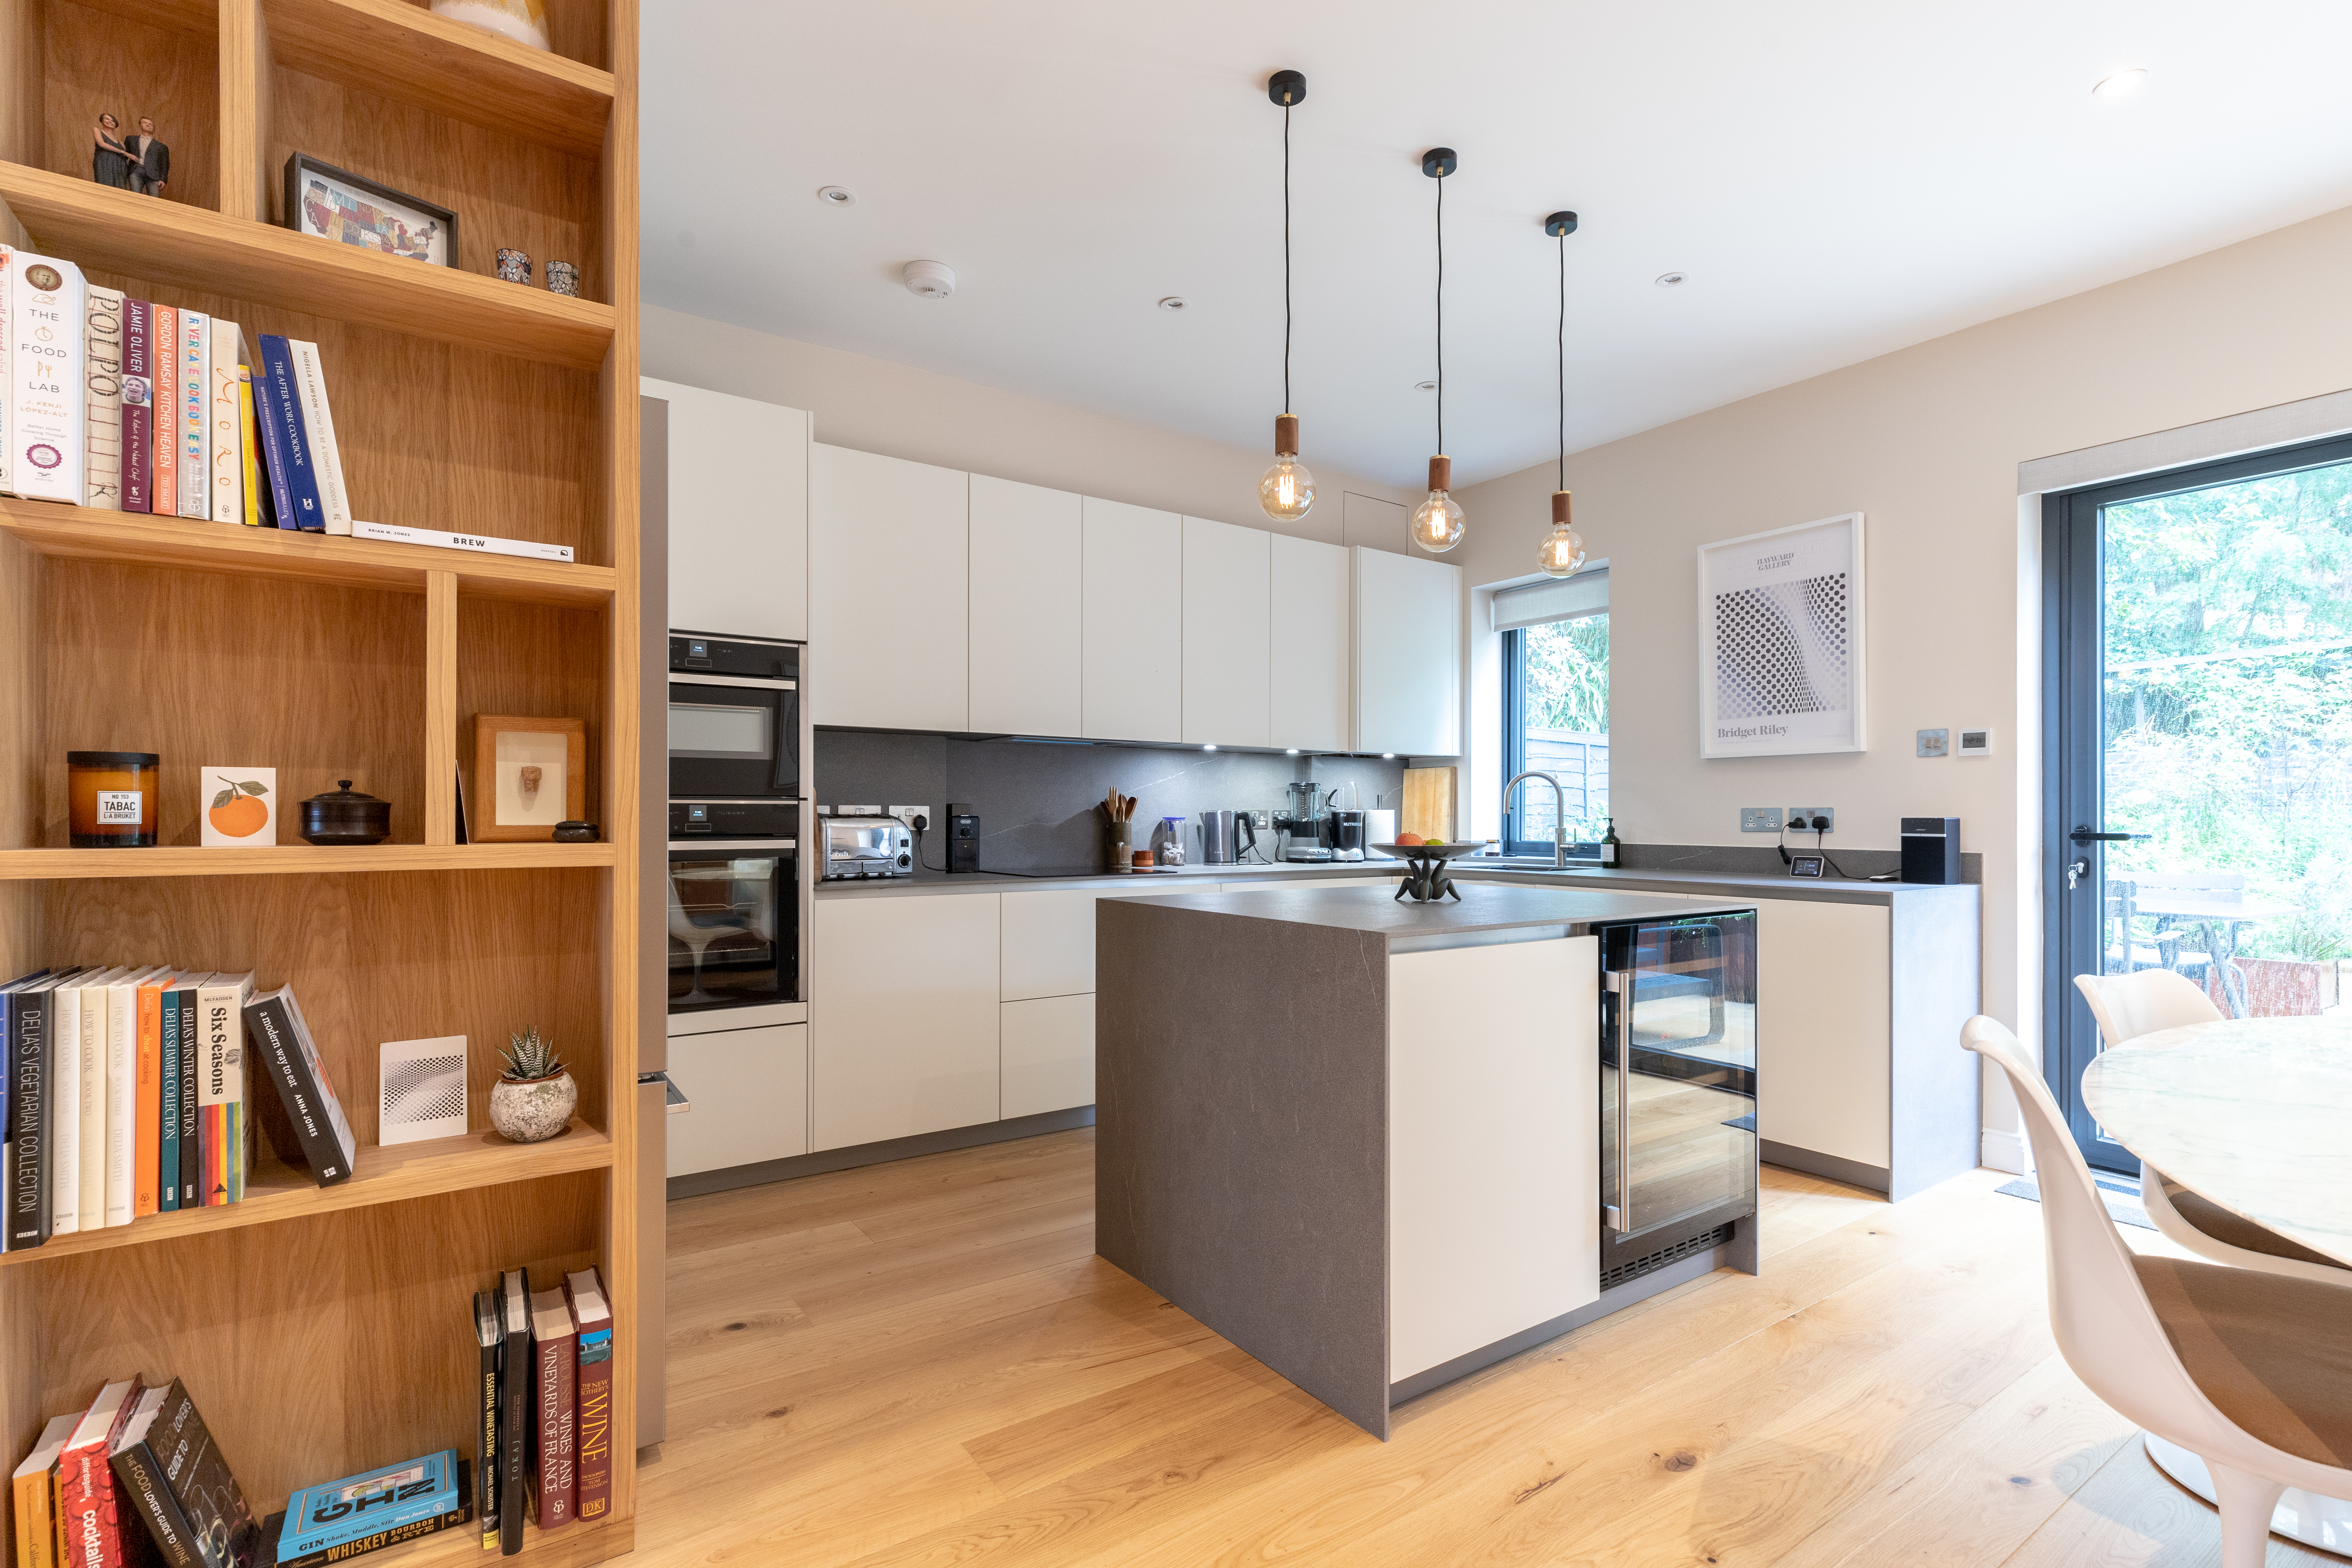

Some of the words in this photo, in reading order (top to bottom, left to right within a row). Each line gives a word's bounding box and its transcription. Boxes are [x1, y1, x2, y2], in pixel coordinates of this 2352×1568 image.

[309, 189, 324, 203] OR
[325, 192, 336, 210] ID
[333, 190, 356, 209] MT
[358, 202, 372, 213] ND
[306, 199, 321, 227] CA
[344, 221, 361, 234] CO
[362, 230, 380, 242] KS
[29, 309, 59, 321] THE
[131, 303, 142, 334] JAMIE
[160, 311, 172, 350] GORDON
[188, 317, 200, 348] RIVER
[22, 344, 66, 358] FOOD
[130, 336, 142, 372] OLIVER
[188, 349, 199, 375] CAFE
[160, 351, 172, 389] RAMSAY
[275, 361, 284, 375] THE
[29, 381, 60, 393] LAB
[188, 377, 199, 404] COOK
[278, 376, 289, 399] AFTER
[20, 407, 67, 417] LÓPEZ-ALT
[160, 390, 172, 430] KITCHEN
[188, 405, 199, 432] BOOK
[284, 401, 295, 423] WORK
[133, 419, 141, 434] Return
[216, 368, 235, 485] MORO
[264, 407, 273, 436] PRESCRIPTION
[271, 446, 279, 466] OPTIMUM
[302, 351, 312, 378] NIGELLA
[308, 380, 318, 408] LAWSON
[322, 452, 333, 479] DOMESTIC
[328, 482, 338, 509] GODDESS
[132, 450, 141, 467] Naked
[160, 431, 171, 468] HEAVEN
[188, 434, 199, 460] EASY
[288, 425, 303, 466] COOKBOOK
[128, 468, 140, 481] Chef
[453, 537, 485, 547] BREW
[1756, 552, 1794, 565] HAYWARD
[1758, 559, 1792, 571] GALLERY
[1718, 726, 1758, 739] Bridget
[1759, 724, 1788, 736] Riley
[104, 802, 136, 811] TABAC
[144, 993, 154, 1013] Delia's
[62, 1009, 71, 1031] HOW
[84, 1009, 94, 1032] HOW
[114, 1006, 124, 1030] HOW
[165, 1008, 176, 1037] DELIA'S
[182, 1008, 194, 1038] DELIA'S
[211, 1007, 227, 1032] Six
[21, 1011, 41, 1054] DELIA'S
[62, 1034, 71, 1044] TO
[85, 1035, 94, 1045] TO
[114, 1031, 124, 1041] TO
[143, 1034, 152, 1052] cheat
[262, 1017, 282, 1049] modern
[61, 1046, 71, 1073] COOK
[84, 1047, 93, 1073] COOK
[113, 1043, 123, 1069] COOK
[165, 1039, 176, 1078] SUMMER
[182, 1040, 195, 1076] WINTER
[211, 1034, 227, 1096] Seasons
[276, 1049, 289, 1067] way
[141, 1060, 150, 1084] cooking
[283, 1065, 292, 1076] to
[286, 1075, 298, 1088] eat
[20, 1058, 40, 1133] VEGETARIAN
[183, 1077, 195, 1137] COLLECTION
[164, 1080, 176, 1140] COLLECTION
[294, 1094, 308, 1114] ANNA
[303, 1115, 318, 1137] JONES
[18, 1136, 38, 1213] COLLECTION
[545, 1344, 557, 1419] VINEYARDS
[560, 1341, 572, 1408] LAROUSSE
[592, 1378, 609, 1389] NEW
[486, 1372, 495, 1410] ESSENTIAL
[581, 1384, 609, 1396] SOTHEBY'S
[486, 1410, 495, 1458] WINETASTING
[545, 1420, 557, 1438] OF
[560, 1409, 572, 1454] WINES
[582, 1390, 608, 1464] WINE
[512, 1440, 521, 1481] TOKAJ
[545, 1439, 557, 1494] FRANCE
[560, 1460, 572, 1489] AND
[580, 1479, 608, 1491] STEVENSON
[125, 1453, 138, 1467] THE
[132, 1464, 152, 1492] FOOD
[144, 1491, 162, 1518] LOVER'S
[156, 1515, 172, 1536] GUIDE
[166, 1532, 176, 1544] TO
[172, 1541, 190, 1565] WINE
[585, 1500, 602, 1514] DK
[298, 1538, 325, 1551] GIN
[326, 1532, 351, 1543] Shake,
[350, 1521, 380, 1536] Muddle,
[380, 1518, 395, 1528] Stir
[395, 1513, 410, 1522] Dan
[410, 1508, 430, 1518] Jones
[390, 1517, 434, 1536] BOURBON
[401, 1525, 434, 1539] RYE
[288, 1556, 325, 1568] American
[327, 1532, 387, 1562] WHISKEY
